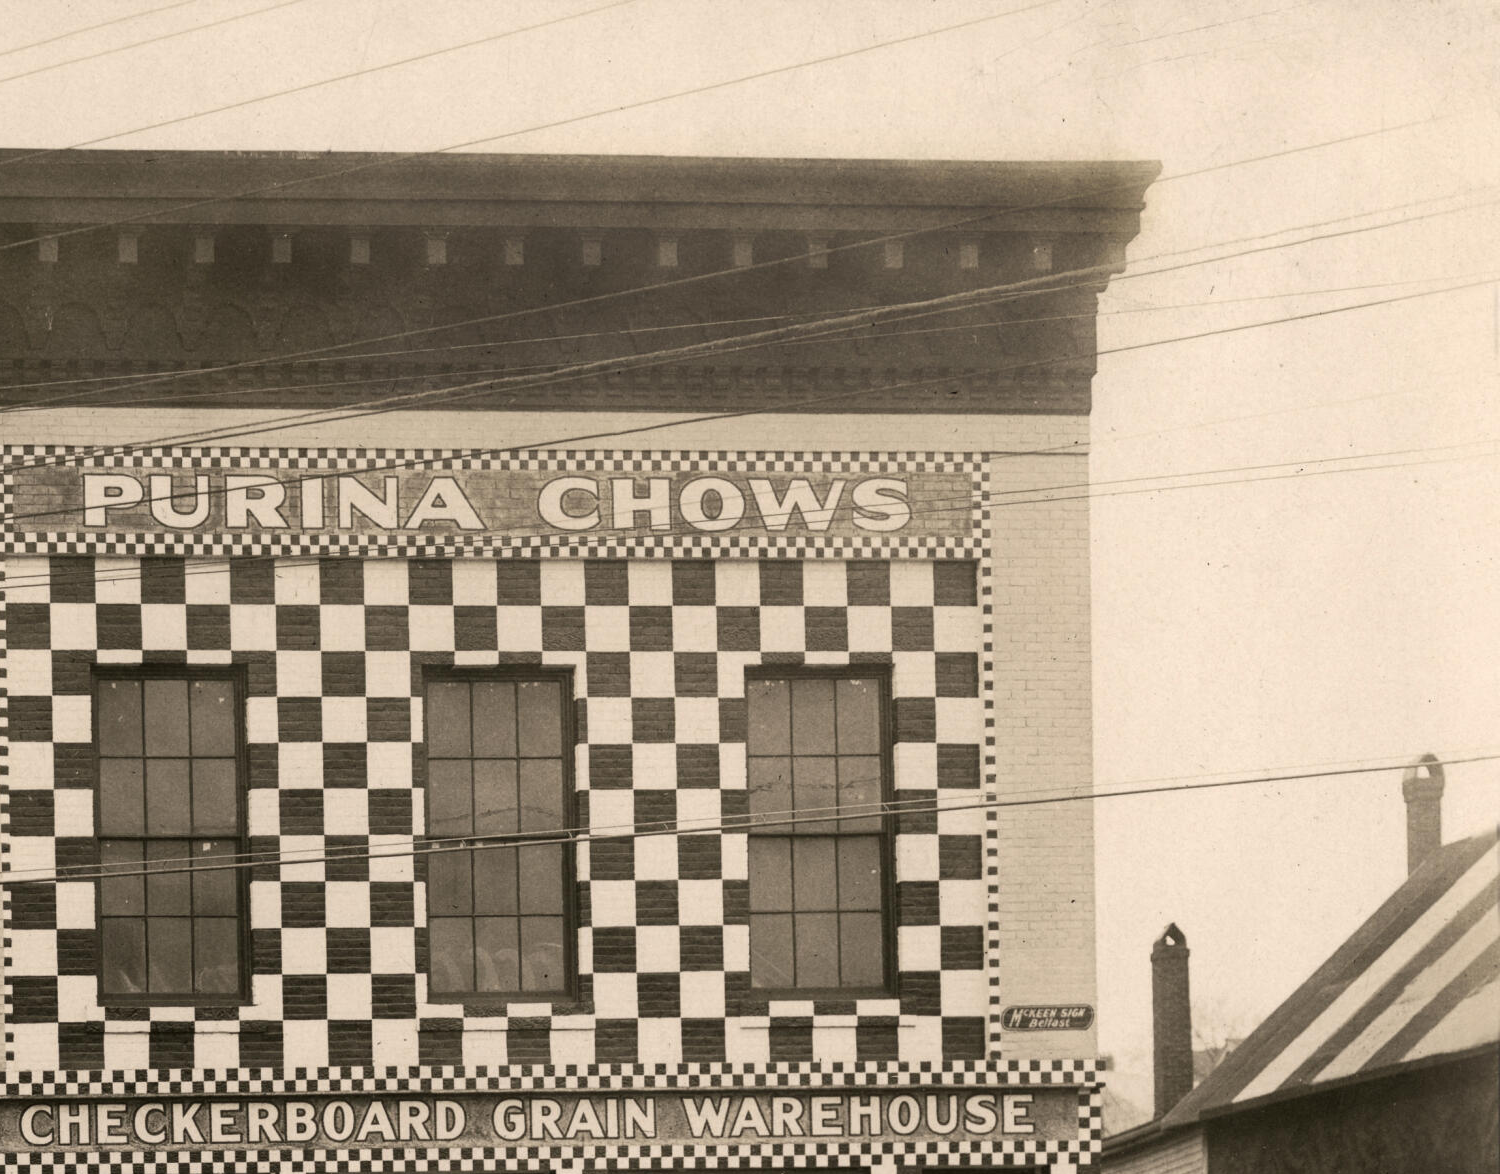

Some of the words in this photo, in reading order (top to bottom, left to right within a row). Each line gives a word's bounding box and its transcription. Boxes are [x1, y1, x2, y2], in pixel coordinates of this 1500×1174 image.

[83, 474, 487, 530] PURINA
[537, 476, 911, 532] CHOWS
[19, 1099, 467, 1146] CHECKERBOARD
[491, 1097, 657, 1140] GRAIN
[682, 1093, 1035, 1139] WAREHOUSE
